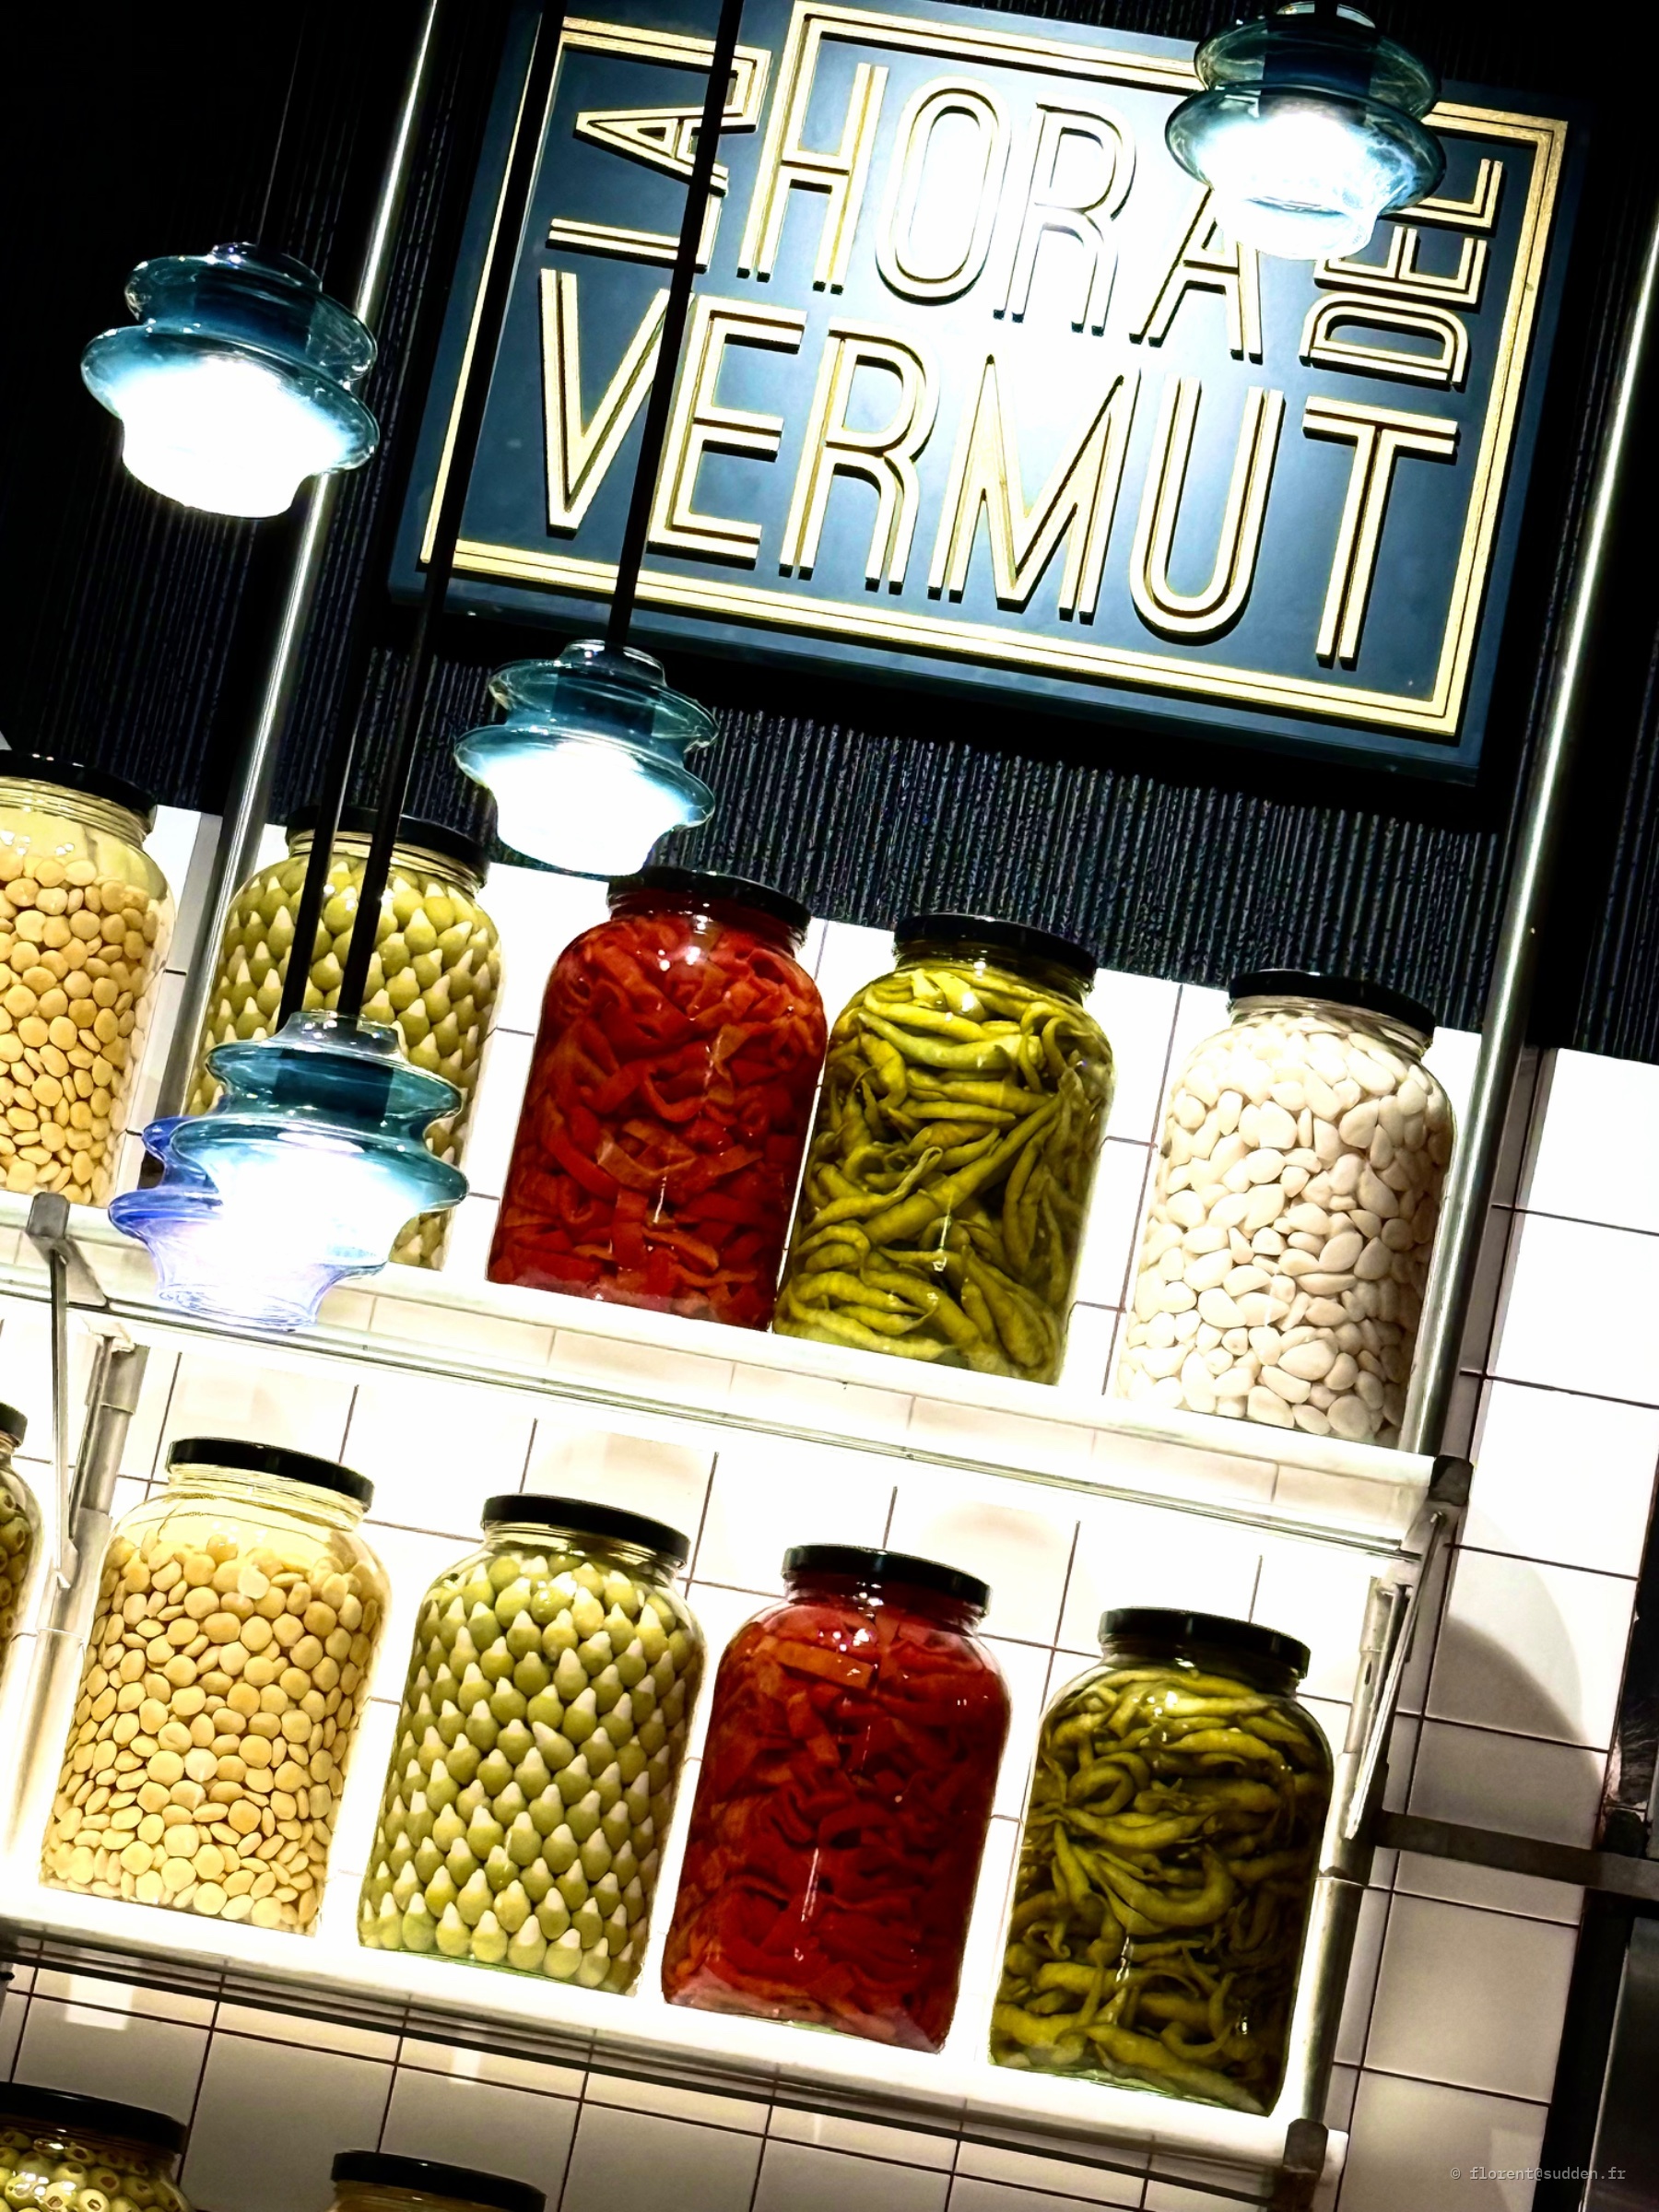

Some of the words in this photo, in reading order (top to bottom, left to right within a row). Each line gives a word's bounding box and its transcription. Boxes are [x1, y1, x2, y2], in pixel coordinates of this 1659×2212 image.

[546, 106, 758, 270] LA
[736, 28, 1264, 361] HORA
[1300, 158, 1504, 384] DEL
[540, 267, 1460, 667] VERMUT
